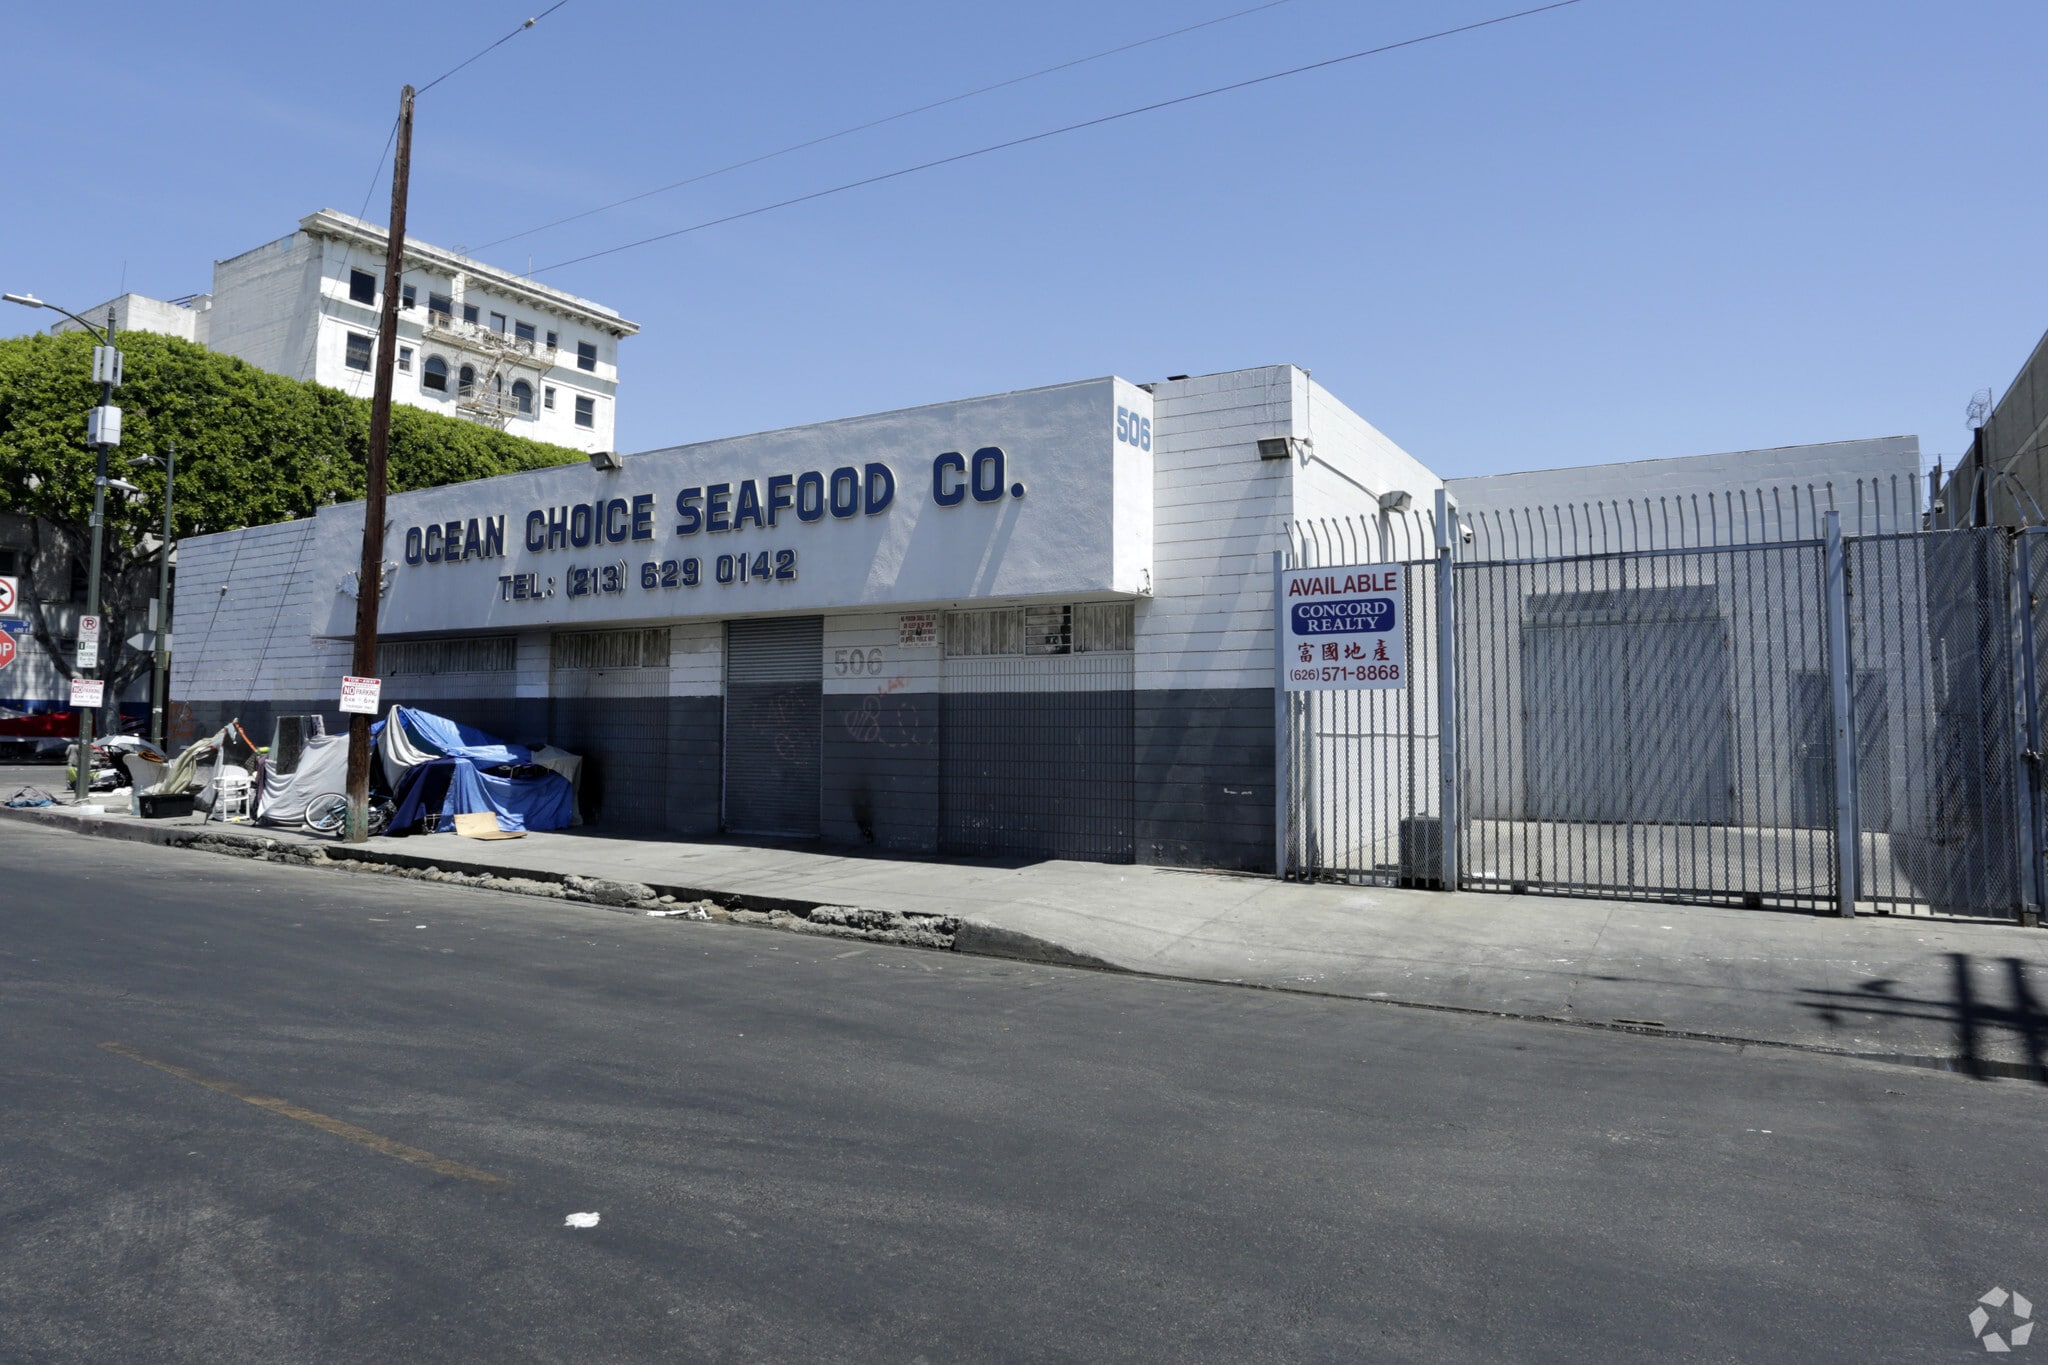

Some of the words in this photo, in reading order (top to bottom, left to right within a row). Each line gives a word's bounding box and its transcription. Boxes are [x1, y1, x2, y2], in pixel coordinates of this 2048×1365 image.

[1117, 408, 1151, 451] 506
[405, 515, 507, 565] OCEAN
[525, 493, 656, 553] CHOICE
[676, 462, 897, 537] SEAFOOD
[932, 446, 1027, 508] CO.
[498, 573, 556, 601] TEL:
[566, 558, 628, 600] (213)
[640, 556, 702, 591] 629
[716, 548, 798, 585] 0142
[1289, 572, 1398, 597] AVAILABLE
[1298, 601, 1388, 619] CONCORD
[1307, 616, 1379, 632] REALTY
[834, 648, 883, 676] 506
[1298, 639, 1390, 663] 富國地產
[1290, 668, 1320, 682] (626)
[1321, 664, 1400, 682] 571-8868
[343, 686, 355, 695] NO
[356, 688, 378, 696] PARKING
